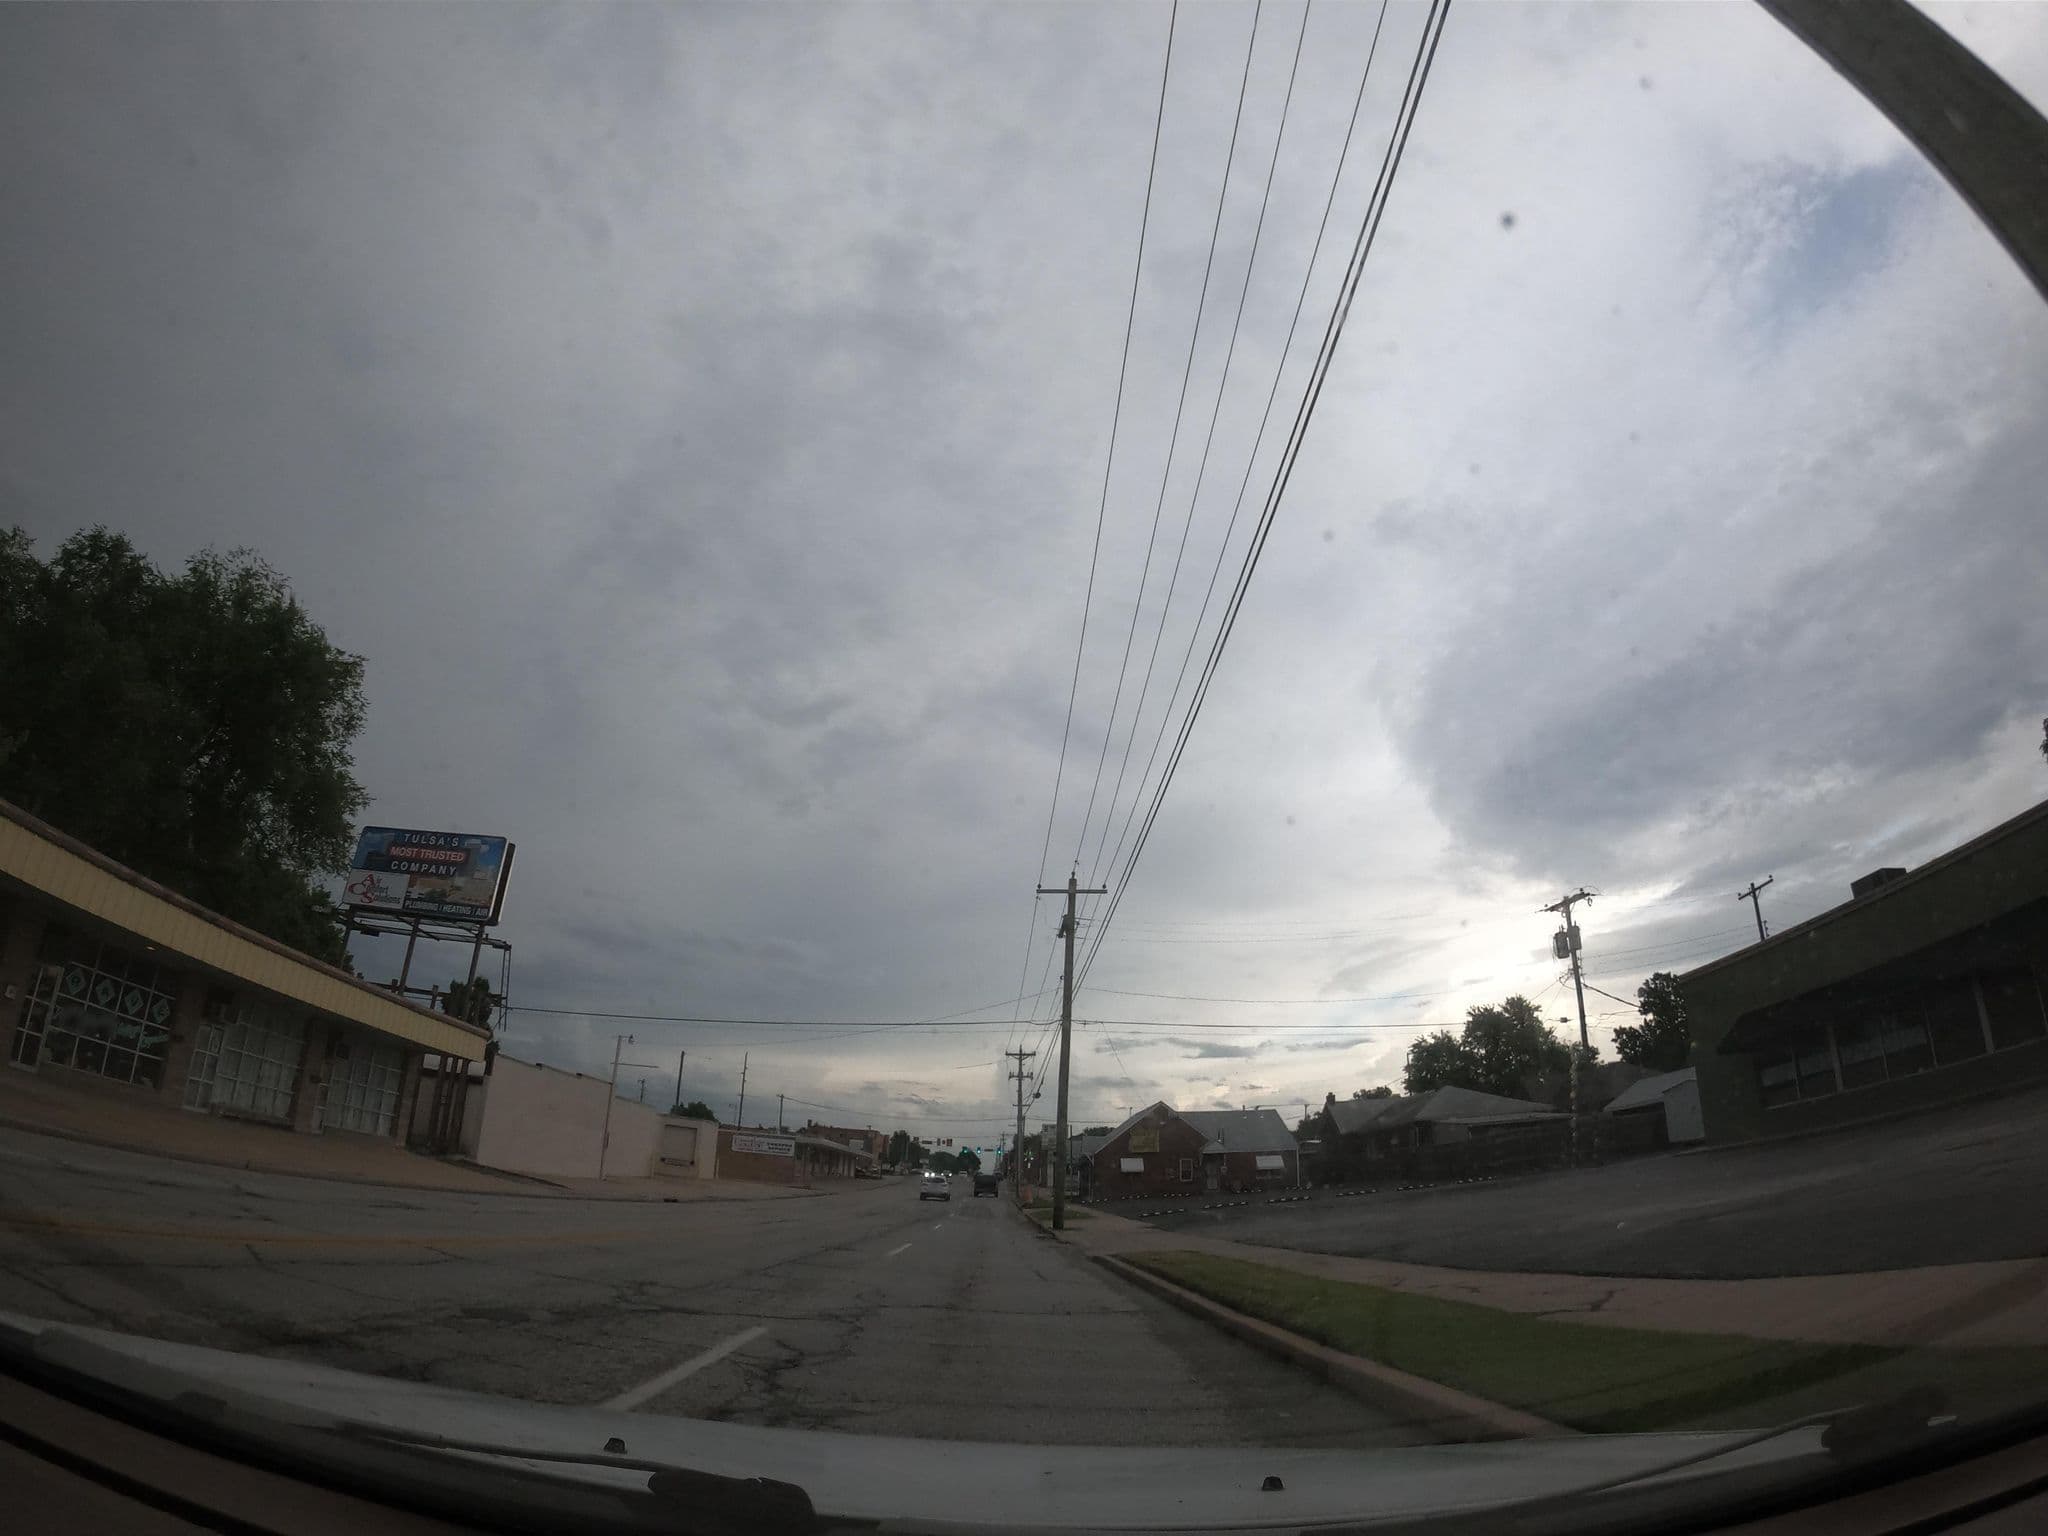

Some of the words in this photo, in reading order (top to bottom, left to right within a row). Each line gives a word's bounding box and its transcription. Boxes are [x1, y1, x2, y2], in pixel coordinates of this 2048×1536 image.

[404, 834, 460, 847] TULSA'S
[389, 846, 418, 858] MOST
[419, 849, 466, 862] TRUSTED
[390, 861, 457, 875] COMPANY
